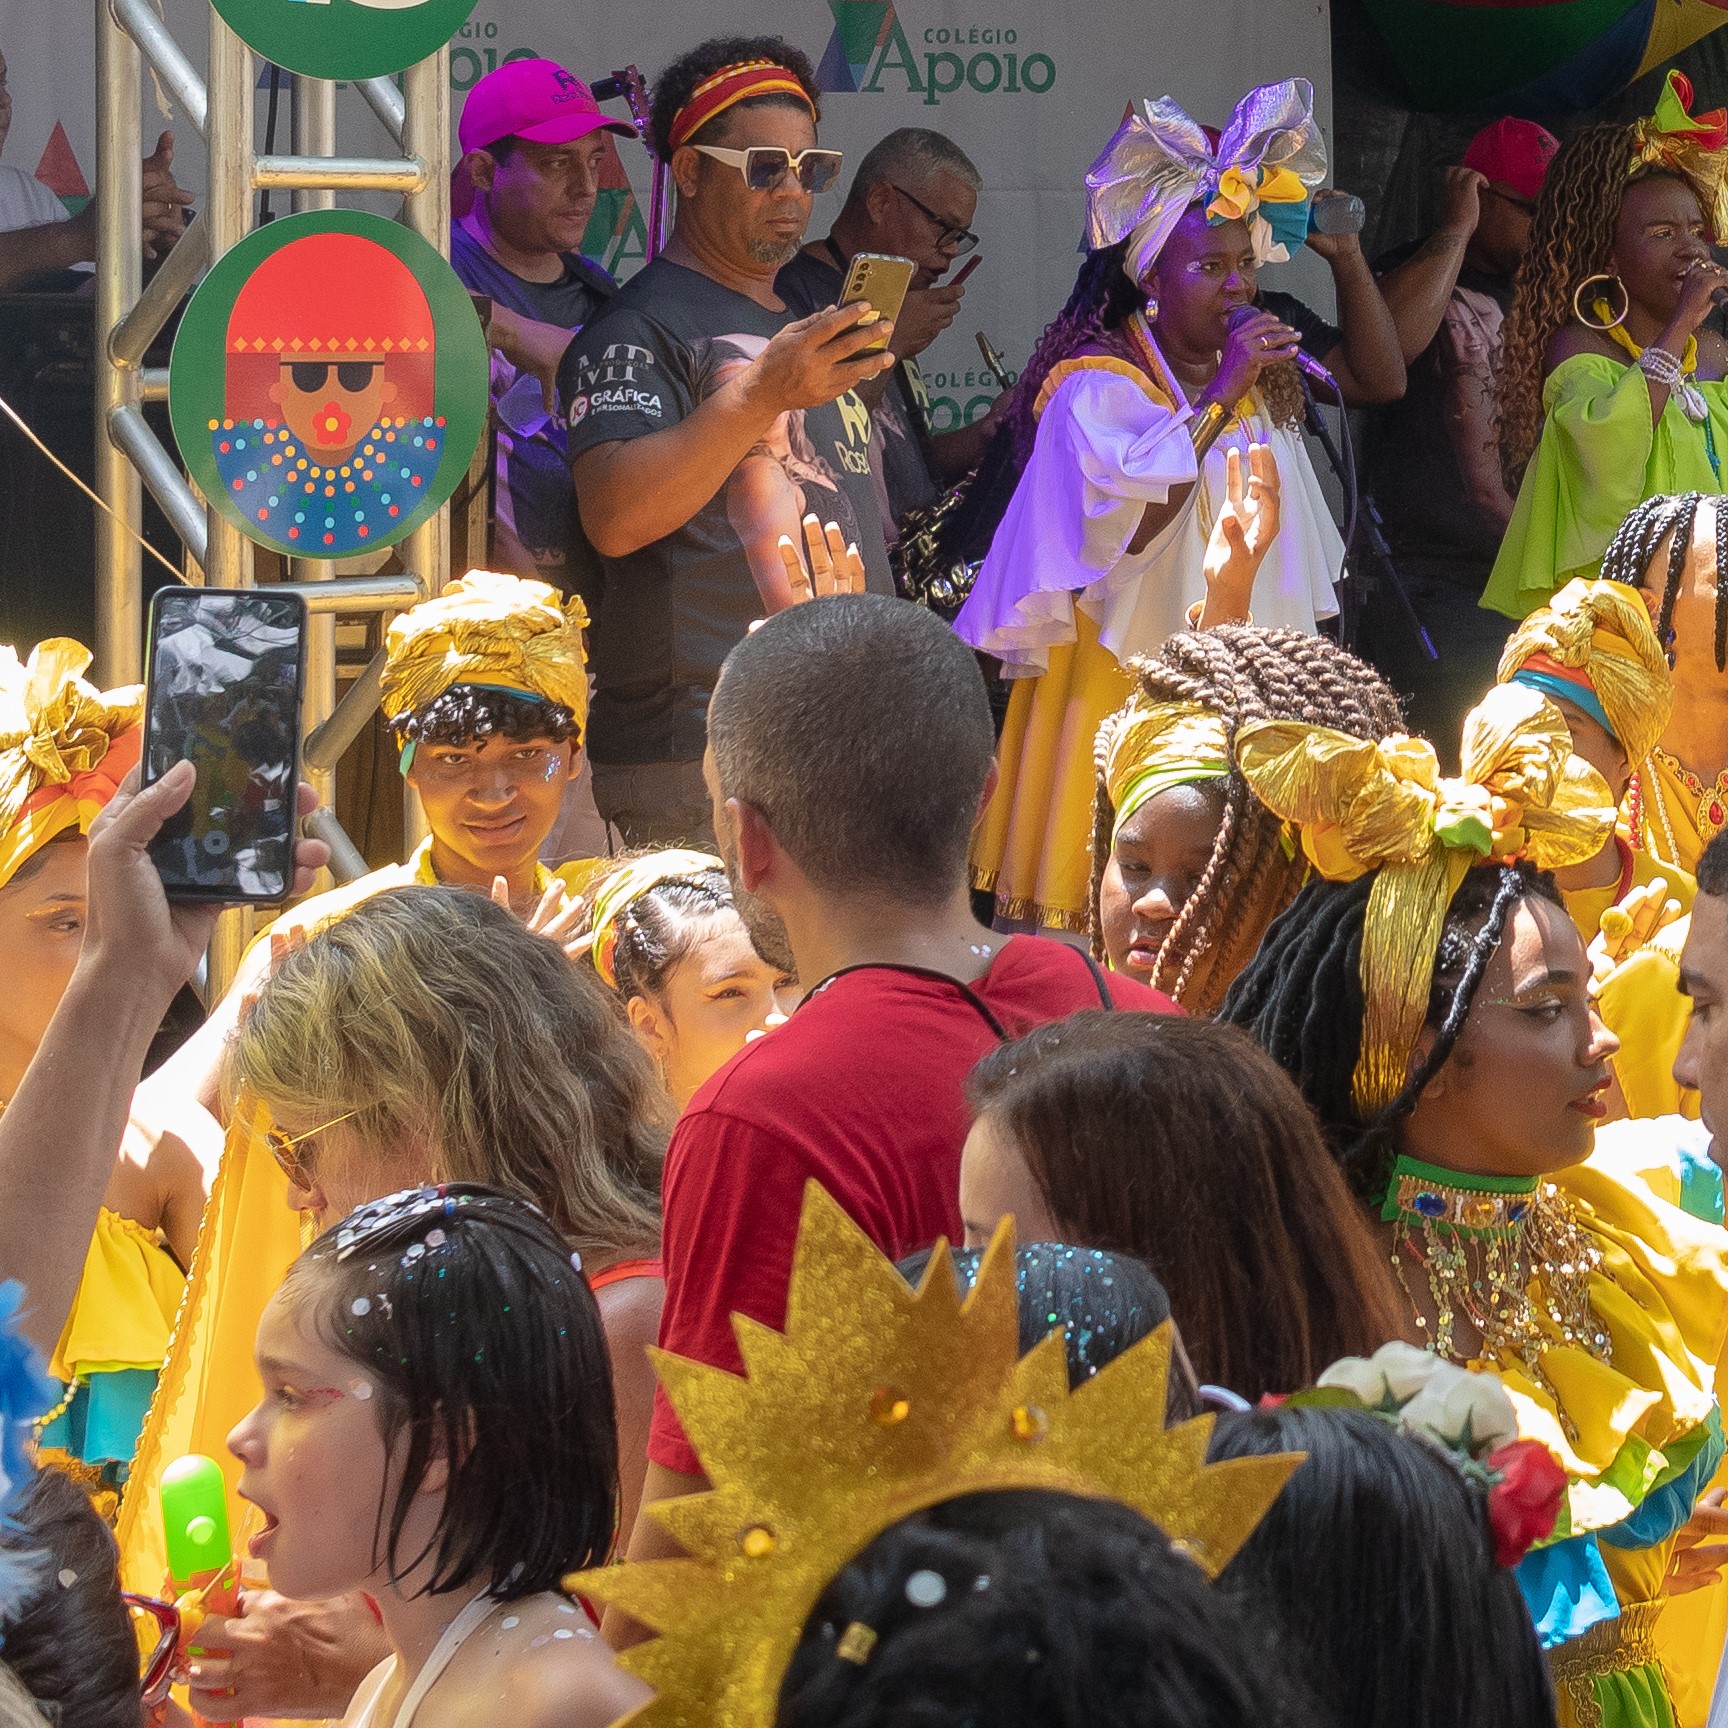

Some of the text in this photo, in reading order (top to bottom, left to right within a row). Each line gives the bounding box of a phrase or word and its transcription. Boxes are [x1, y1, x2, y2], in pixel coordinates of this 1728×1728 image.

[923, 24, 1018, 45] COLÉGIO
[860, 9, 1057, 106] Apoio
[922, 366, 1018, 390] COLÉGO
[590, 386, 662, 410] GRÁFICA
